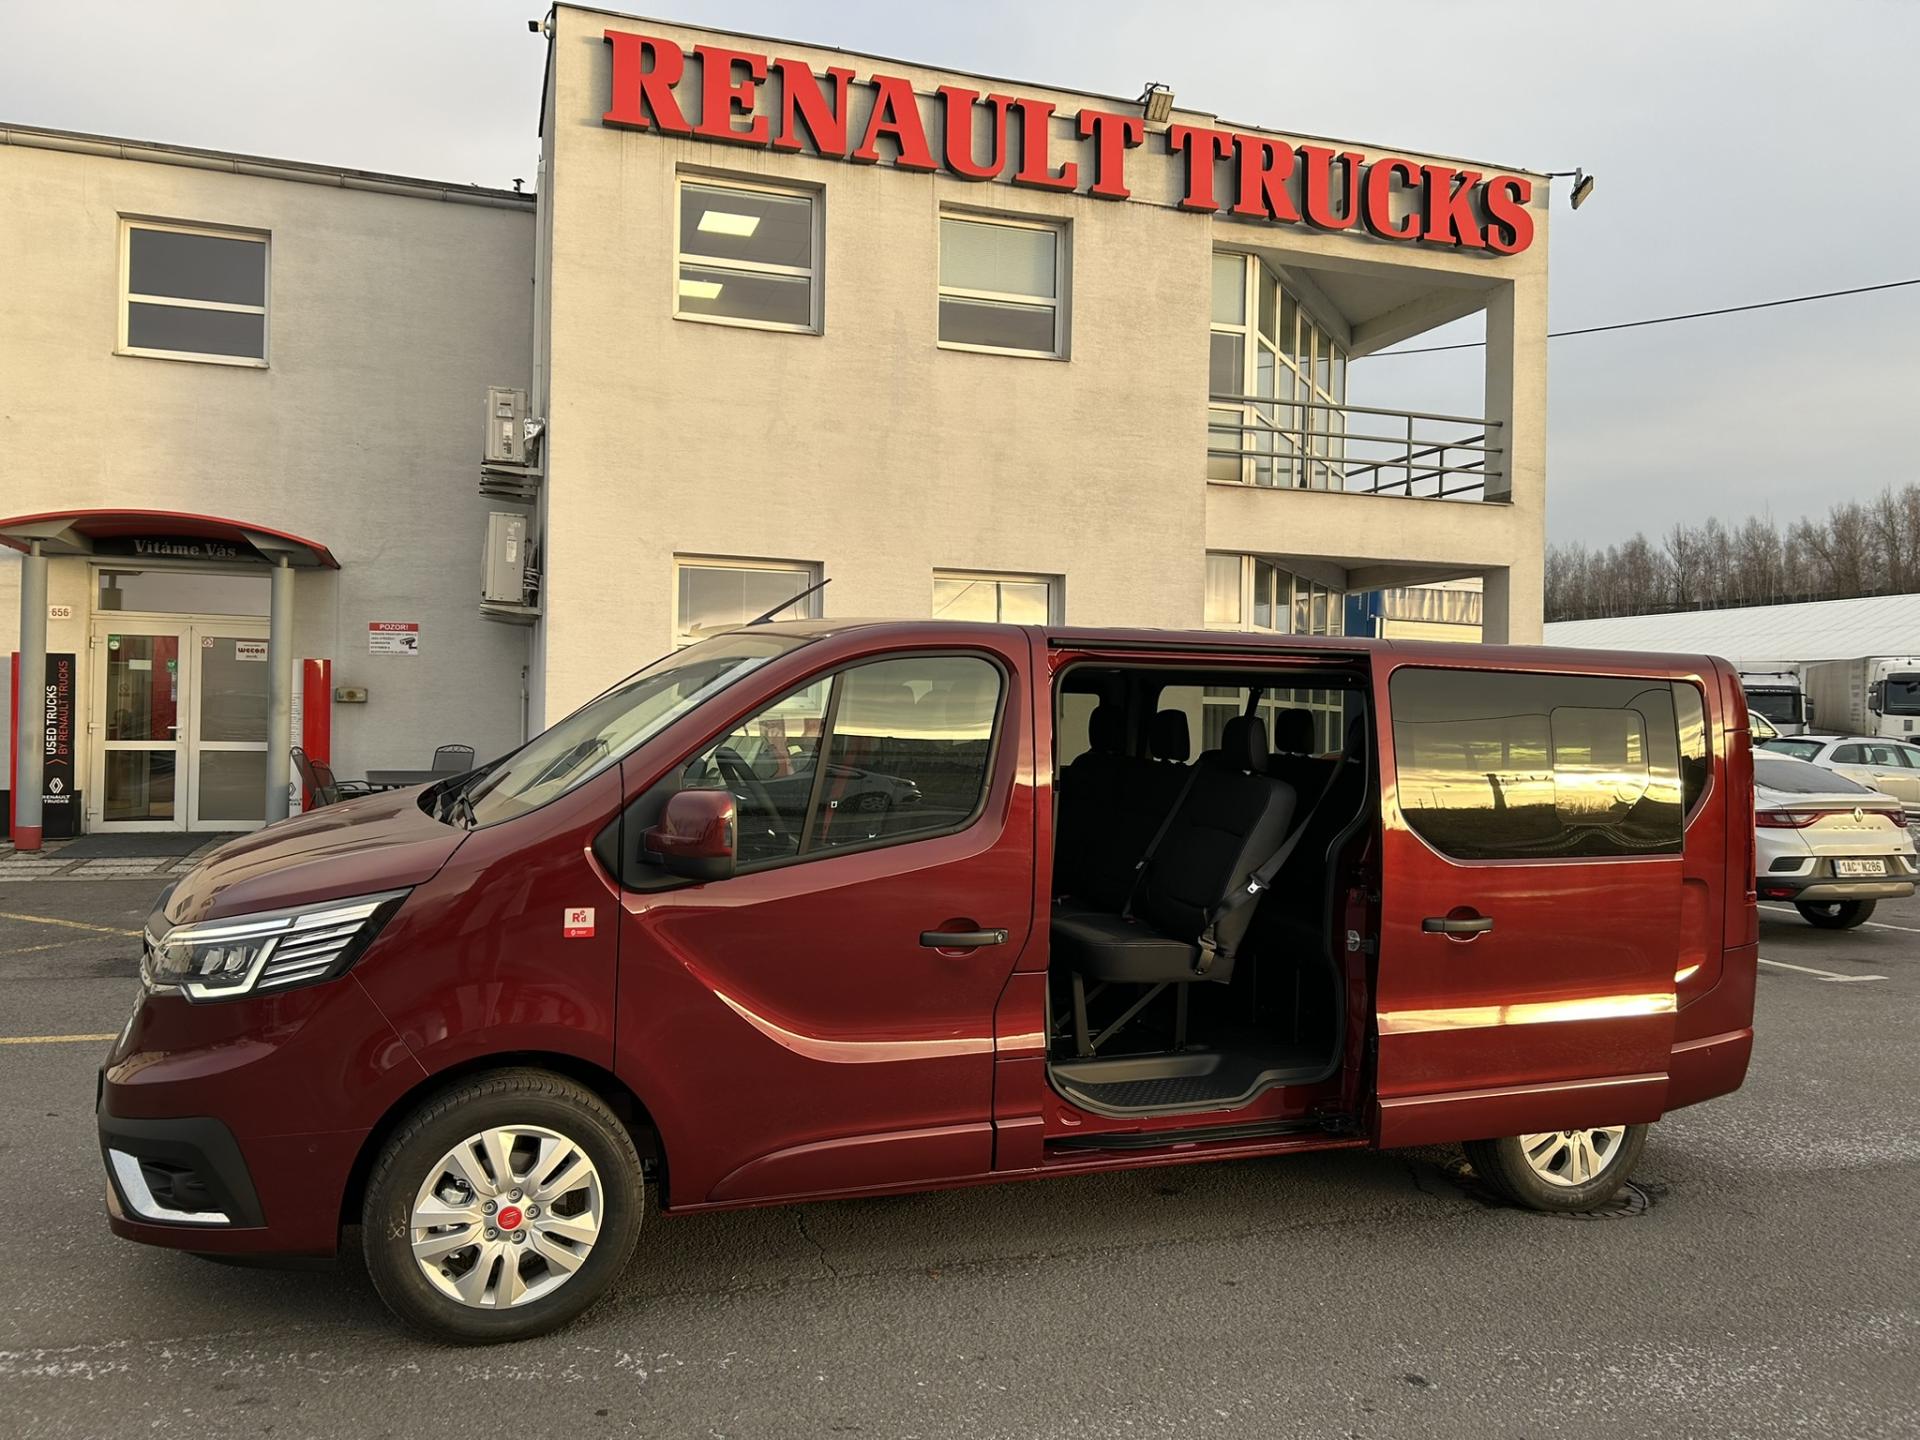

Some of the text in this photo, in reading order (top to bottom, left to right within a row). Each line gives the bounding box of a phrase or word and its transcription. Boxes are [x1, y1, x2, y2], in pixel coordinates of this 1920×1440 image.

[602, 29, 1535, 258] RENAULT TRUCKS
[134, 539, 237, 557] Vitáme Vás
[51, 607, 70, 617] 656
[46, 685, 57, 755] USED TRUCKS
[58, 660, 68, 755] BY RENAULT TRUCKS
